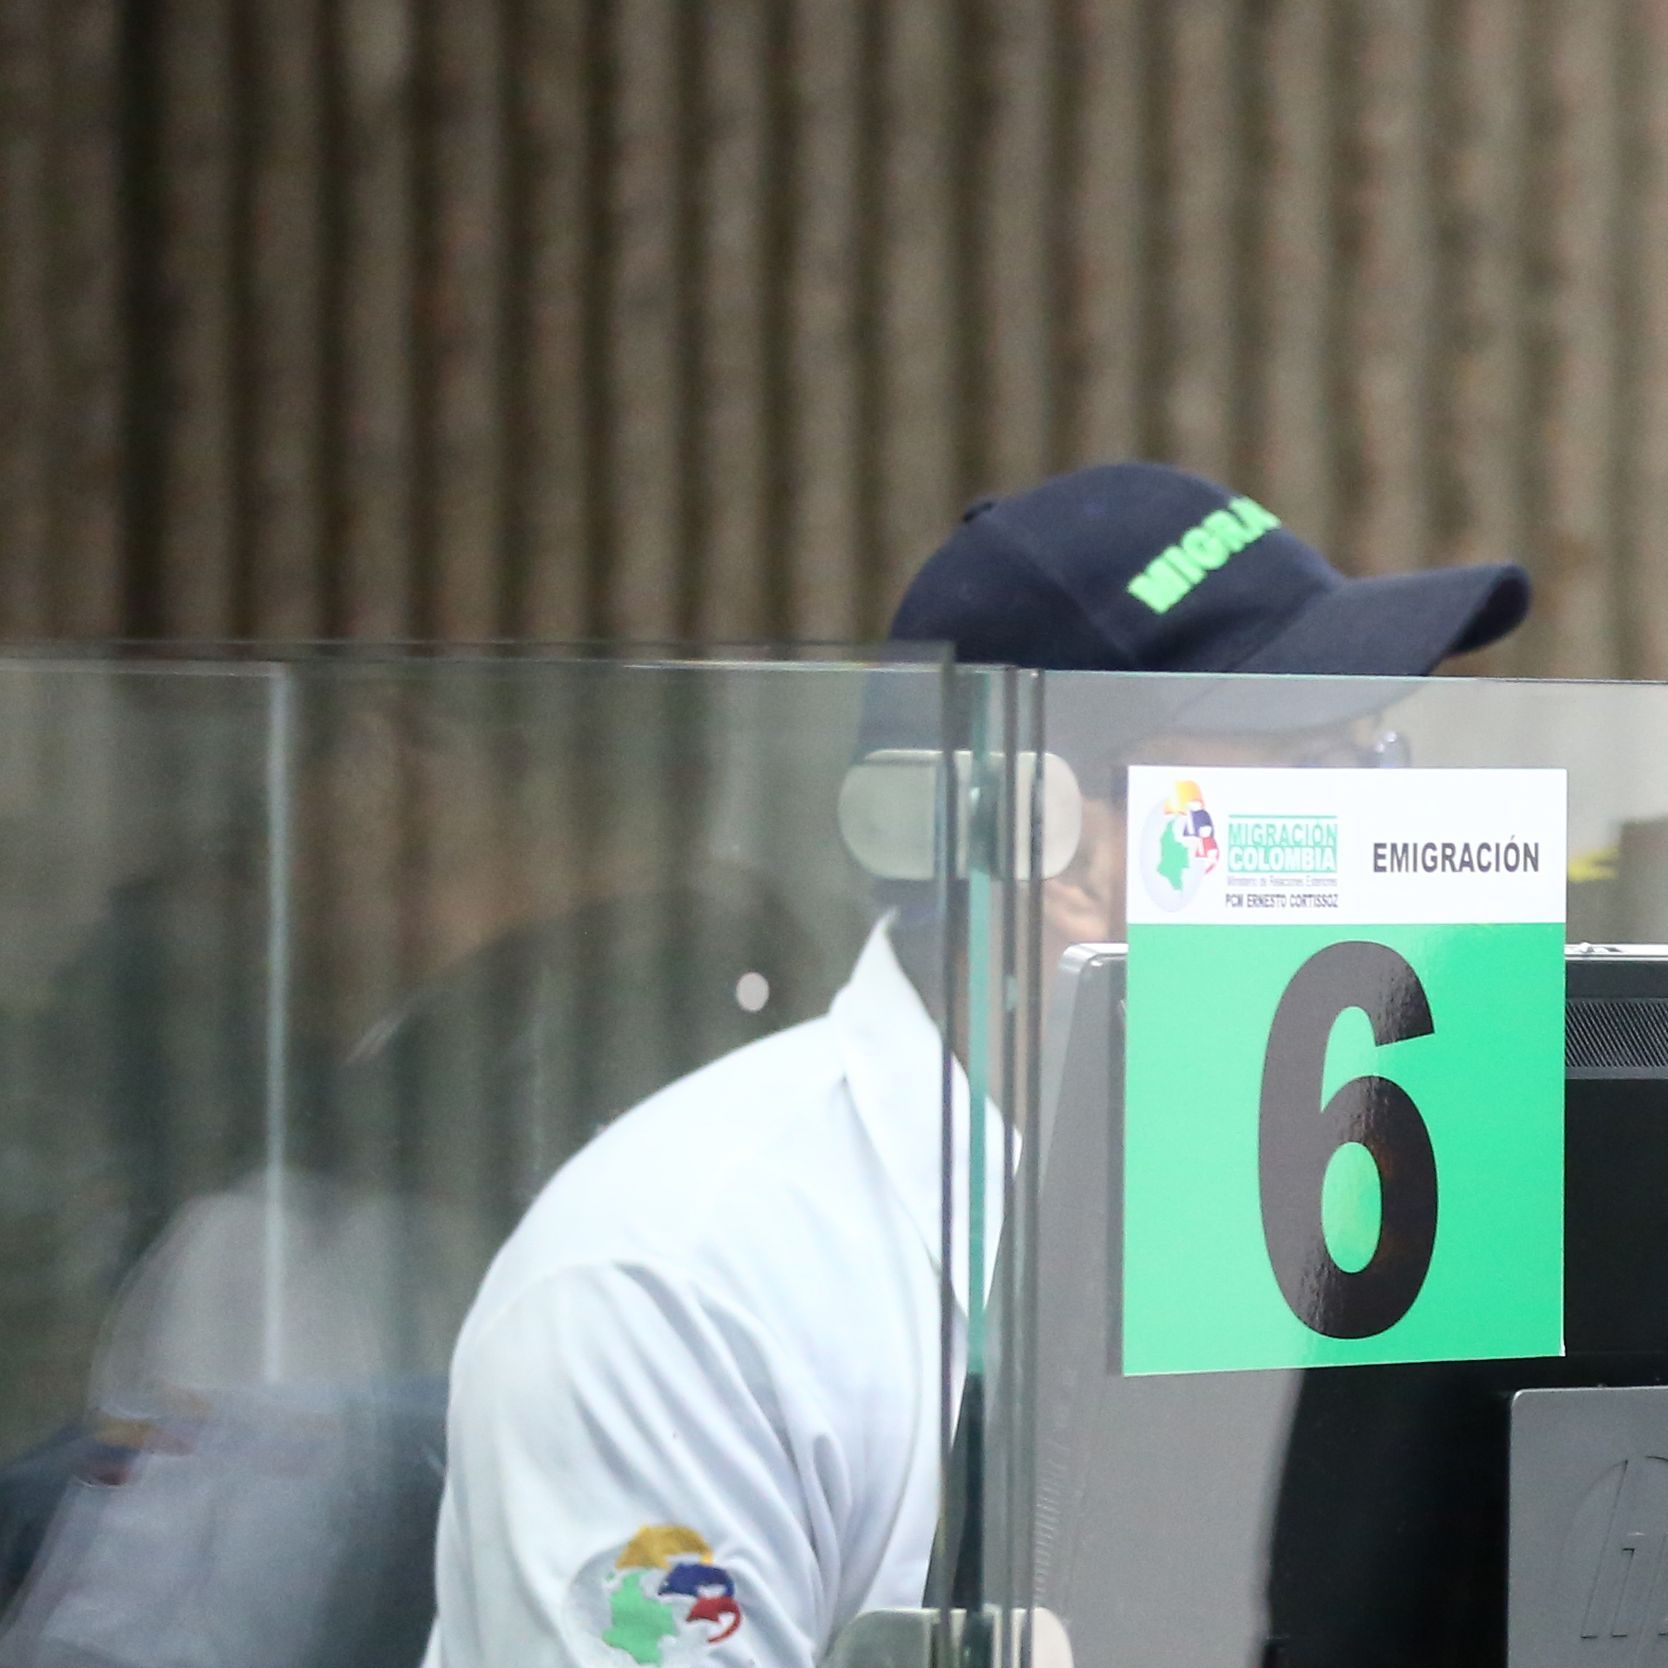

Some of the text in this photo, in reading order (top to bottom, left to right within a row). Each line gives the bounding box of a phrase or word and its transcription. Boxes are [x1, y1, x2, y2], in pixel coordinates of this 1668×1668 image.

[1229, 846, 1337, 870] COLOMBIA
[1373, 835, 1539, 872] EMIGRACIÓN
[1258, 940, 1438, 1340] 6
